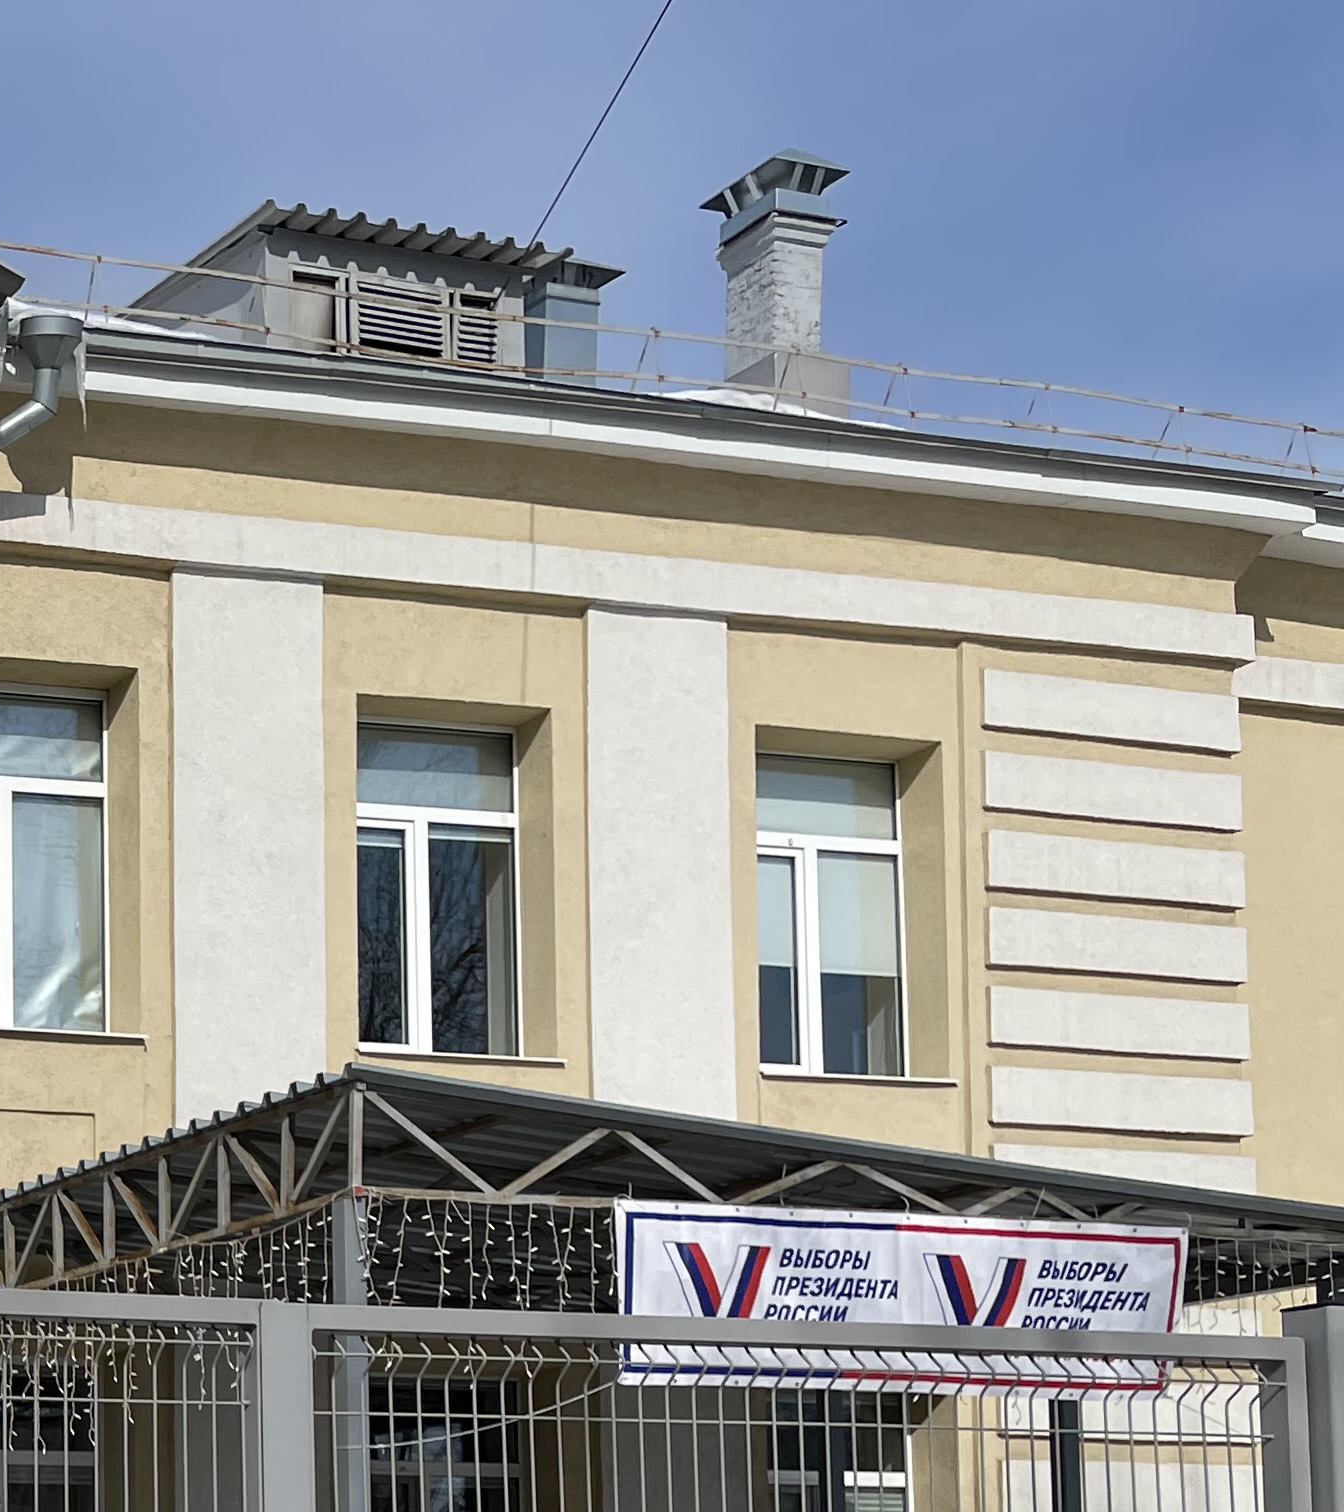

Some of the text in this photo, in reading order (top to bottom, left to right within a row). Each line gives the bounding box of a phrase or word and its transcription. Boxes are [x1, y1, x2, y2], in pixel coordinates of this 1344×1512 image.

[779, 1247, 871, 1270] ВЫБОРЫ
[1037, 1259, 1128, 1283] ВЫБОРЫ
[772, 1276, 899, 1300] ПРЕЗИДЕНТА
[1028, 1287, 1151, 1313] ПРЕЗИДЕНТА
[764, 1304, 849, 1322] РОССИИ
[1021, 1315, 1092, 1331] РОССИИ
